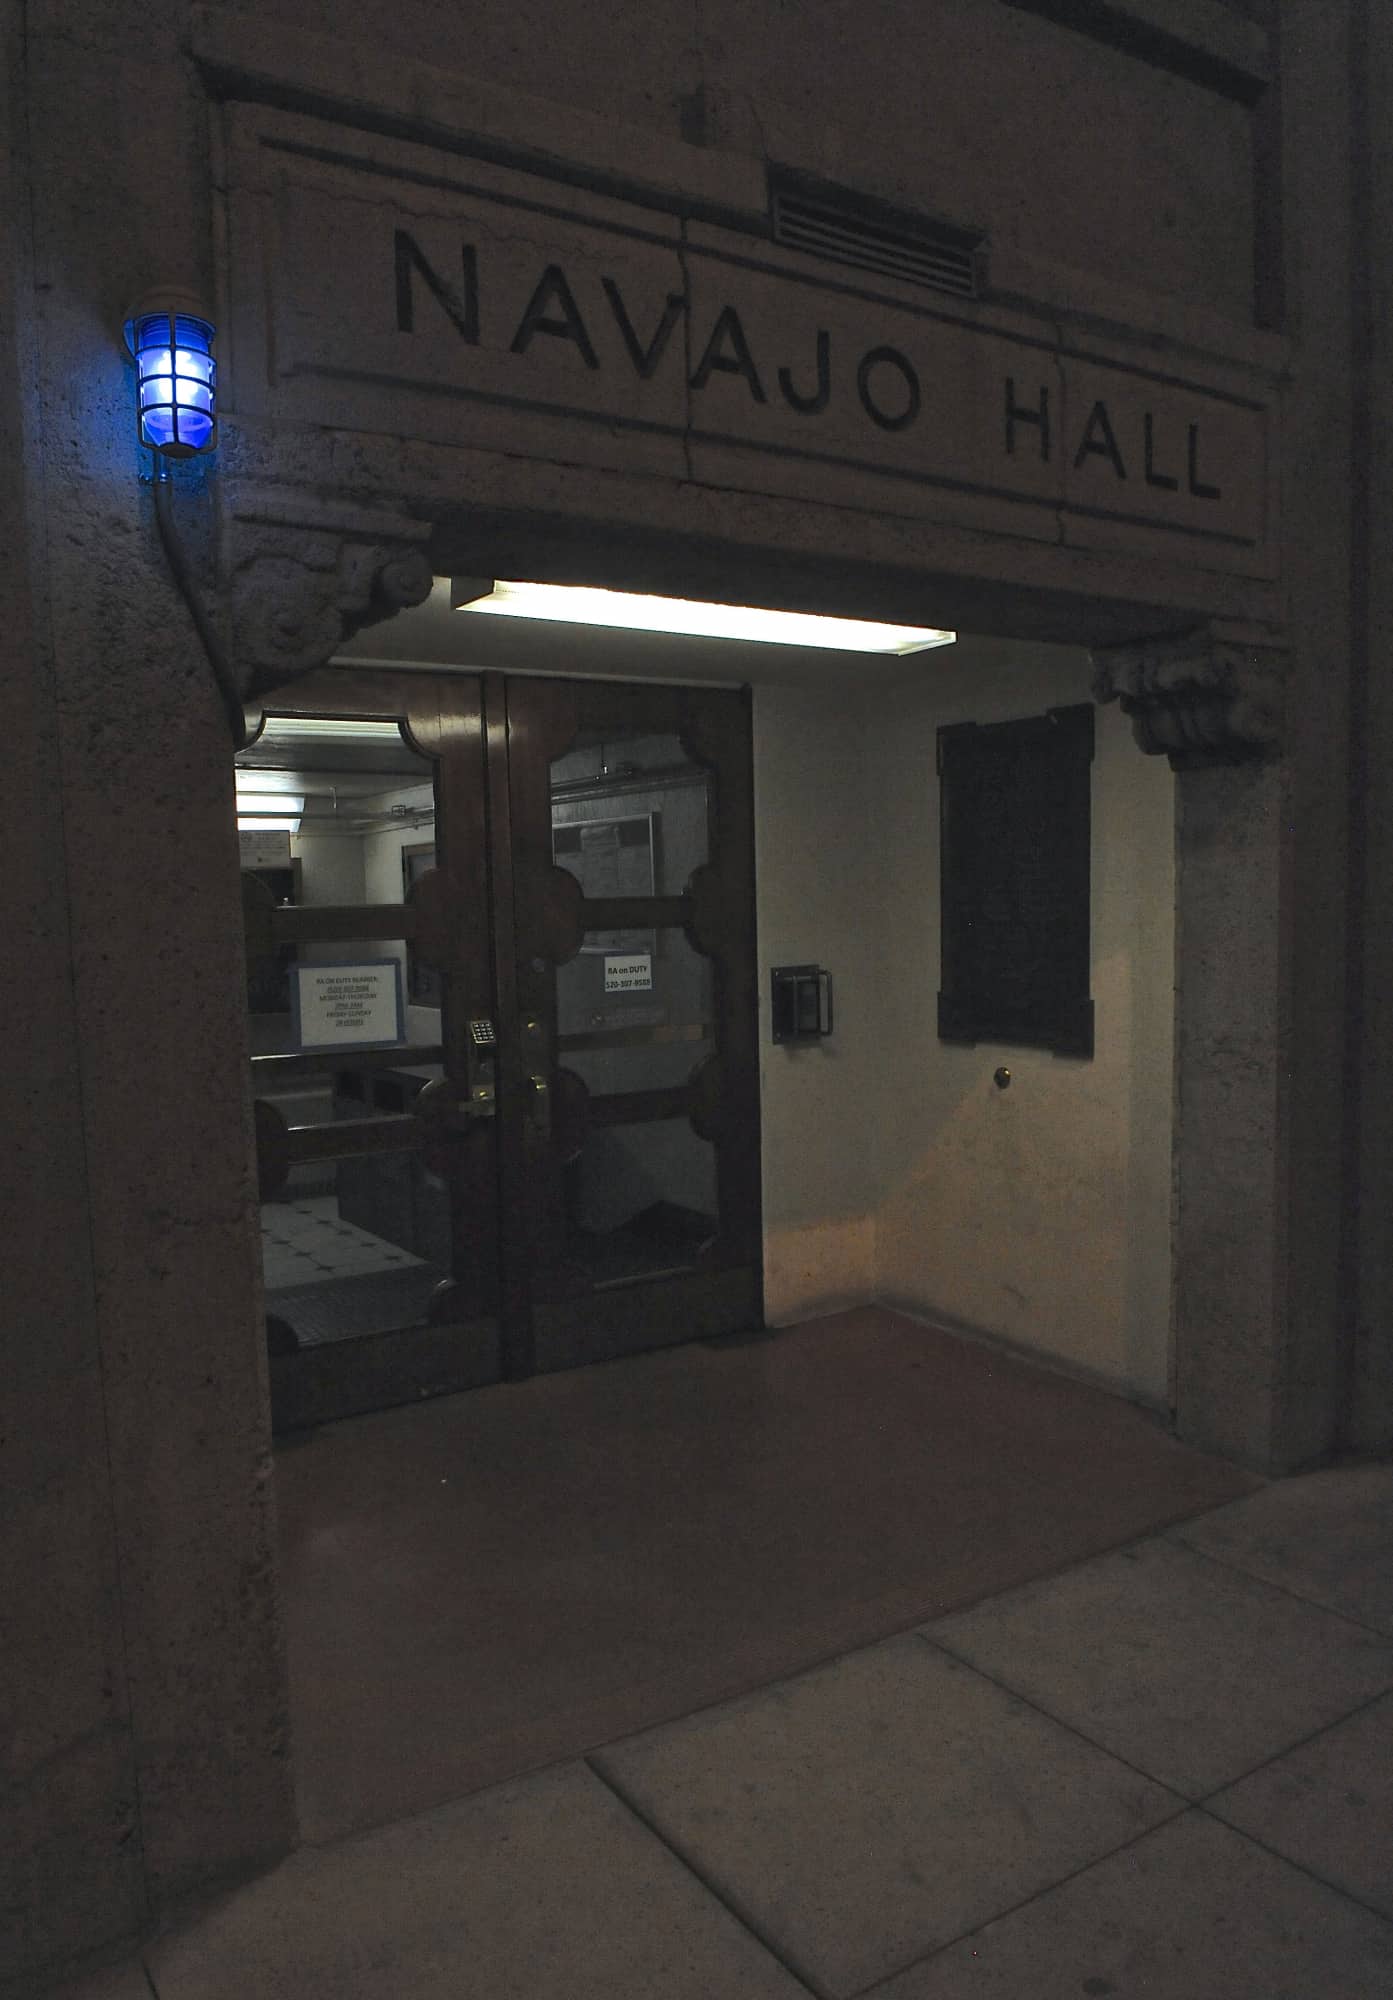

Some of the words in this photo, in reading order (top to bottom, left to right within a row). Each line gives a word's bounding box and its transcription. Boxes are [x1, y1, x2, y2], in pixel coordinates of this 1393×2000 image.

[394, 229, 920, 432] NAVAJO
[1005, 377, 1221, 499] HALL
[629, 965, 648, 974] DUTY
